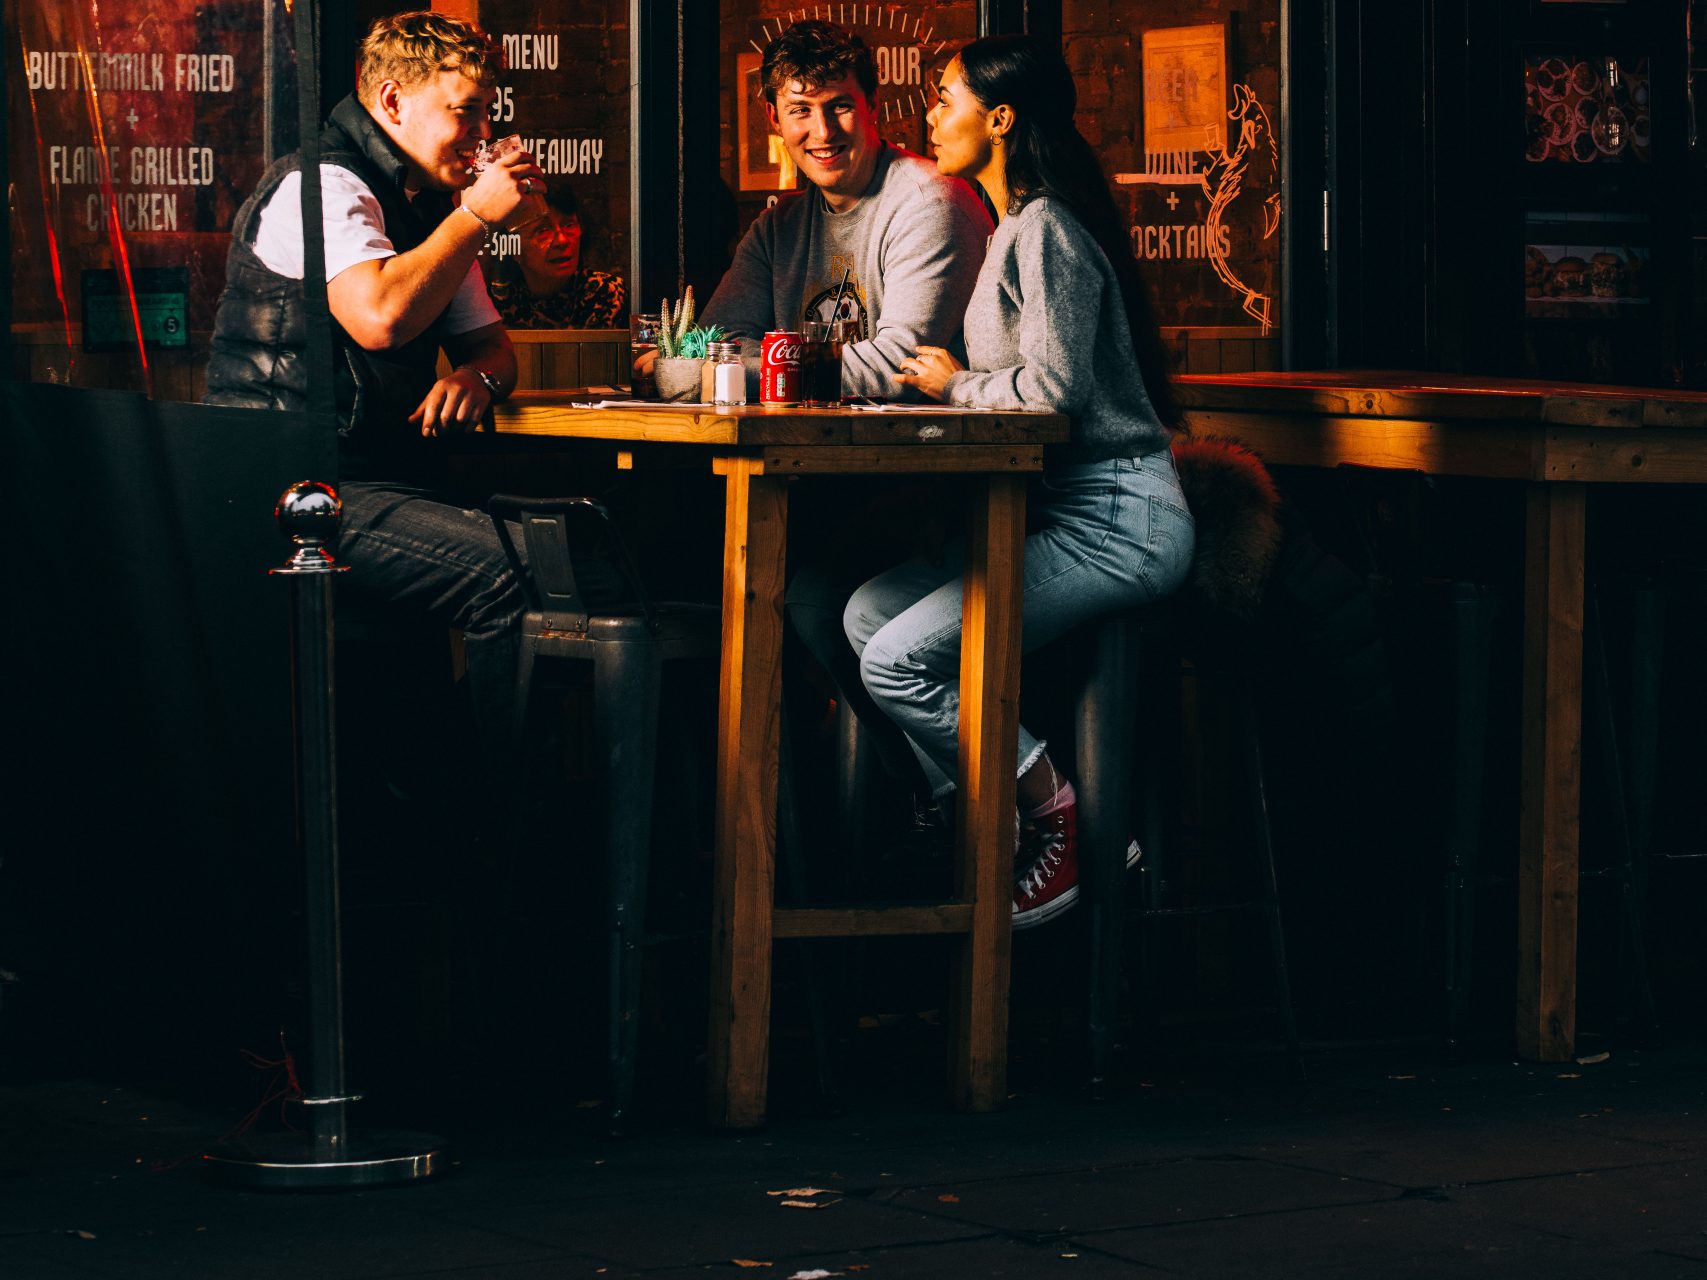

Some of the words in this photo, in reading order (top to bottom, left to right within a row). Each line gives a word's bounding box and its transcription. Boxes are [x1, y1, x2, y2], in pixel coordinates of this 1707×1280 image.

[502, 34, 559, 70] MENU
[873, 46, 921, 85] OUR
[175, 54, 234, 92] FRIED
[131, 147, 213, 186] GRILLED
[1131, 224, 1231, 260] OCKTAILS
[167, 318, 176, 333] 5
